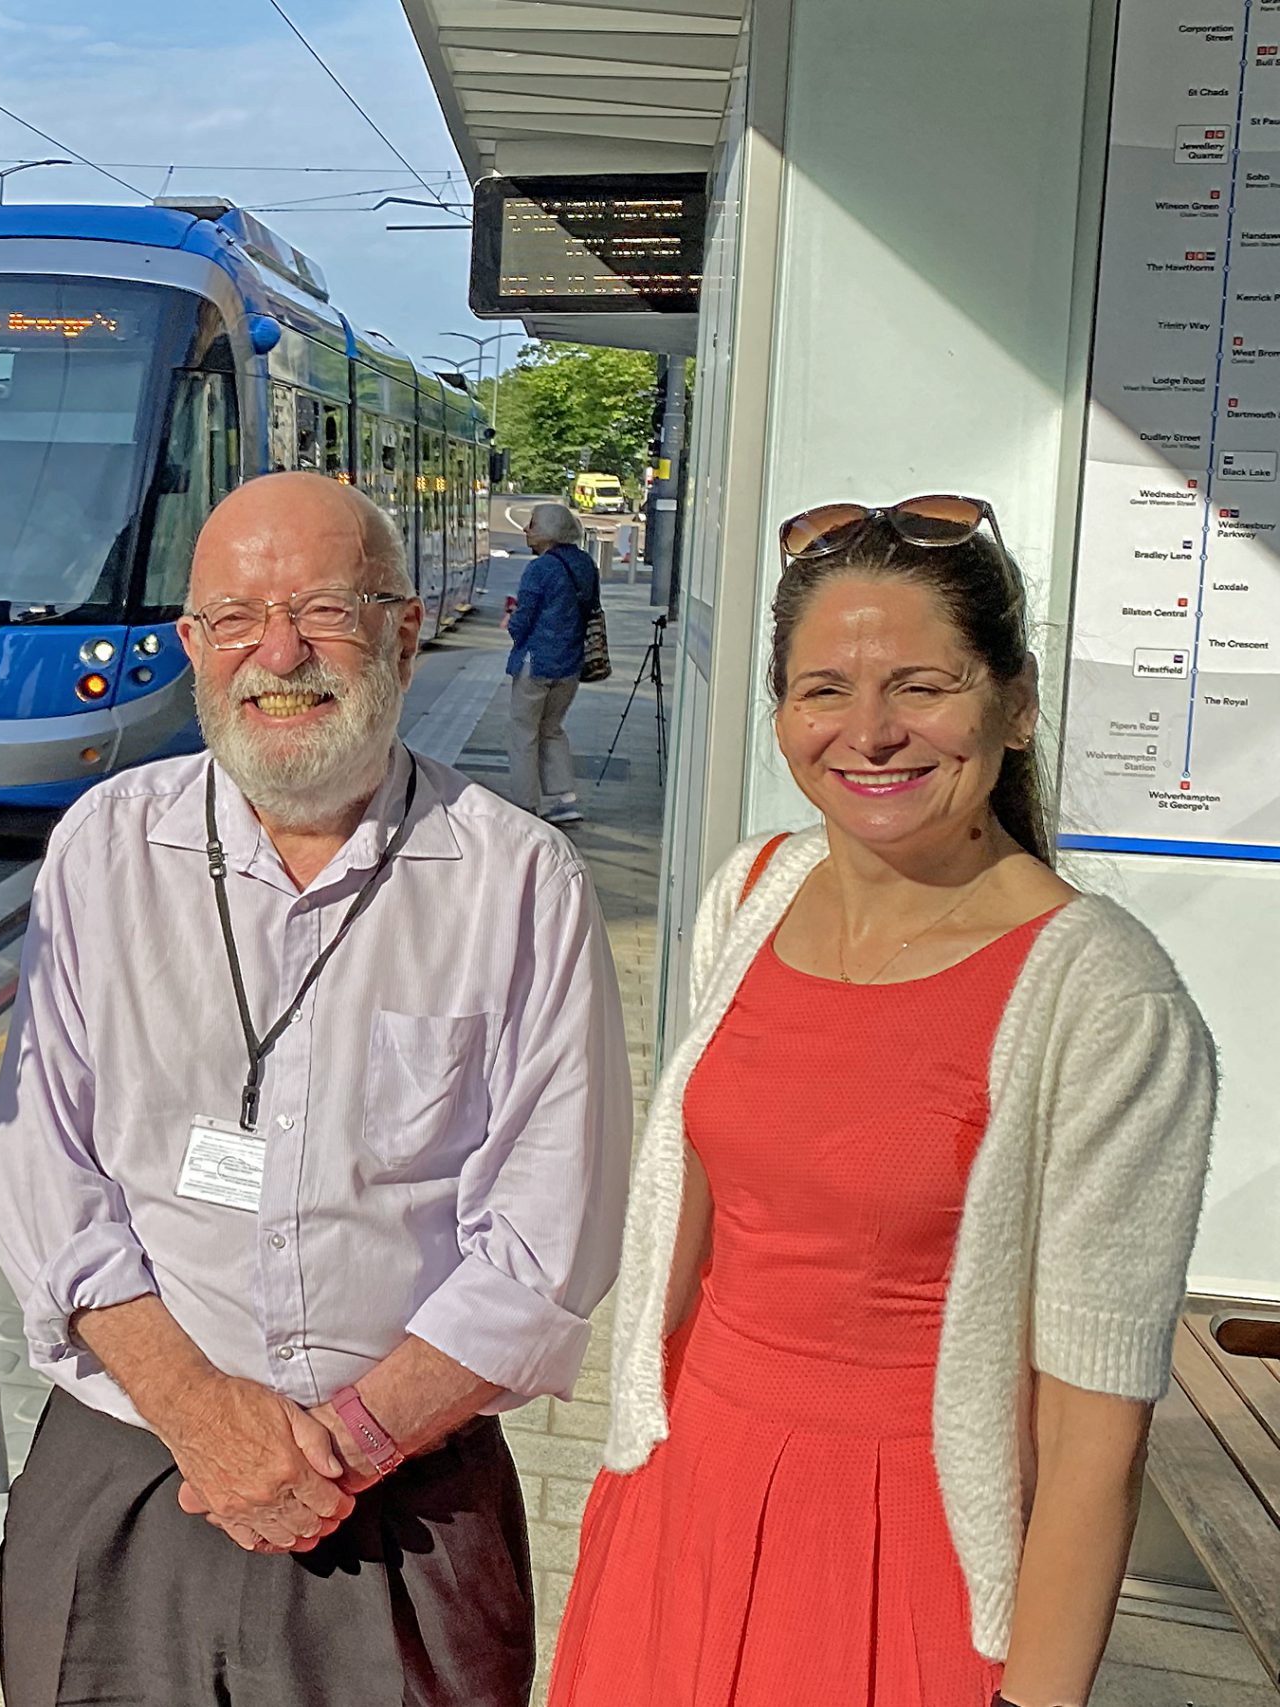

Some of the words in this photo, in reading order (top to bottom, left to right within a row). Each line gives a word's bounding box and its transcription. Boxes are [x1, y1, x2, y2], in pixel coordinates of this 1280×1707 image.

[1179, 25, 1234, 33] Corporation
[1180, 143, 1225, 151] Jewellery
[1188, 152, 1224, 160] Quarter
[1246, 173, 1270, 181] Soho
[1155, 202, 1189, 210] Winson
[1192, 202, 1219, 210] Green
[1165, 264, 1214, 272] Hawthorns
[1158, 322, 1187, 331] Trinity
[1189, 322, 1210, 331] Way
[1232, 349, 1255, 357] West
[1153, 377, 1181, 385] Lodge
[1183, 377, 1205, 385] Road
[1227, 411, 1276, 419] Dartmouth
[1140, 433, 1172, 441] Dudley
[1174, 433, 1200, 441] Street
[1223, 468, 1246, 476] Black
[1140, 490, 1197, 499] Wednesbury
[1218, 521, 1276, 530] Wednesbury
[1217, 530, 1257, 539] Parkway
[1135, 551, 1168, 560] Bradley
[1170, 552, 1192, 560] Lane
[1213, 583, 1249, 591] Loxdale
[1122, 607, 1152, 616] Bilston
[1154, 609, 1188, 618] Central
[1209, 639, 1225, 648] The
[1228, 640, 1269, 649] Crescent
[1138, 665, 1183, 674] Priestfield
[1204, 697, 1221, 705] The
[1223, 698, 1248, 706] Royal
[1110, 722, 1137, 731] Pipers
[1139, 722, 1160, 731] Row
[1086, 751, 1157, 762] Wolverhampton
[1124, 763, 1156, 772] Station
[1149, 791, 1220, 803] Wolverhampton
[1158, 800, 1167, 809] St
[1170, 801, 1209, 811] George's
